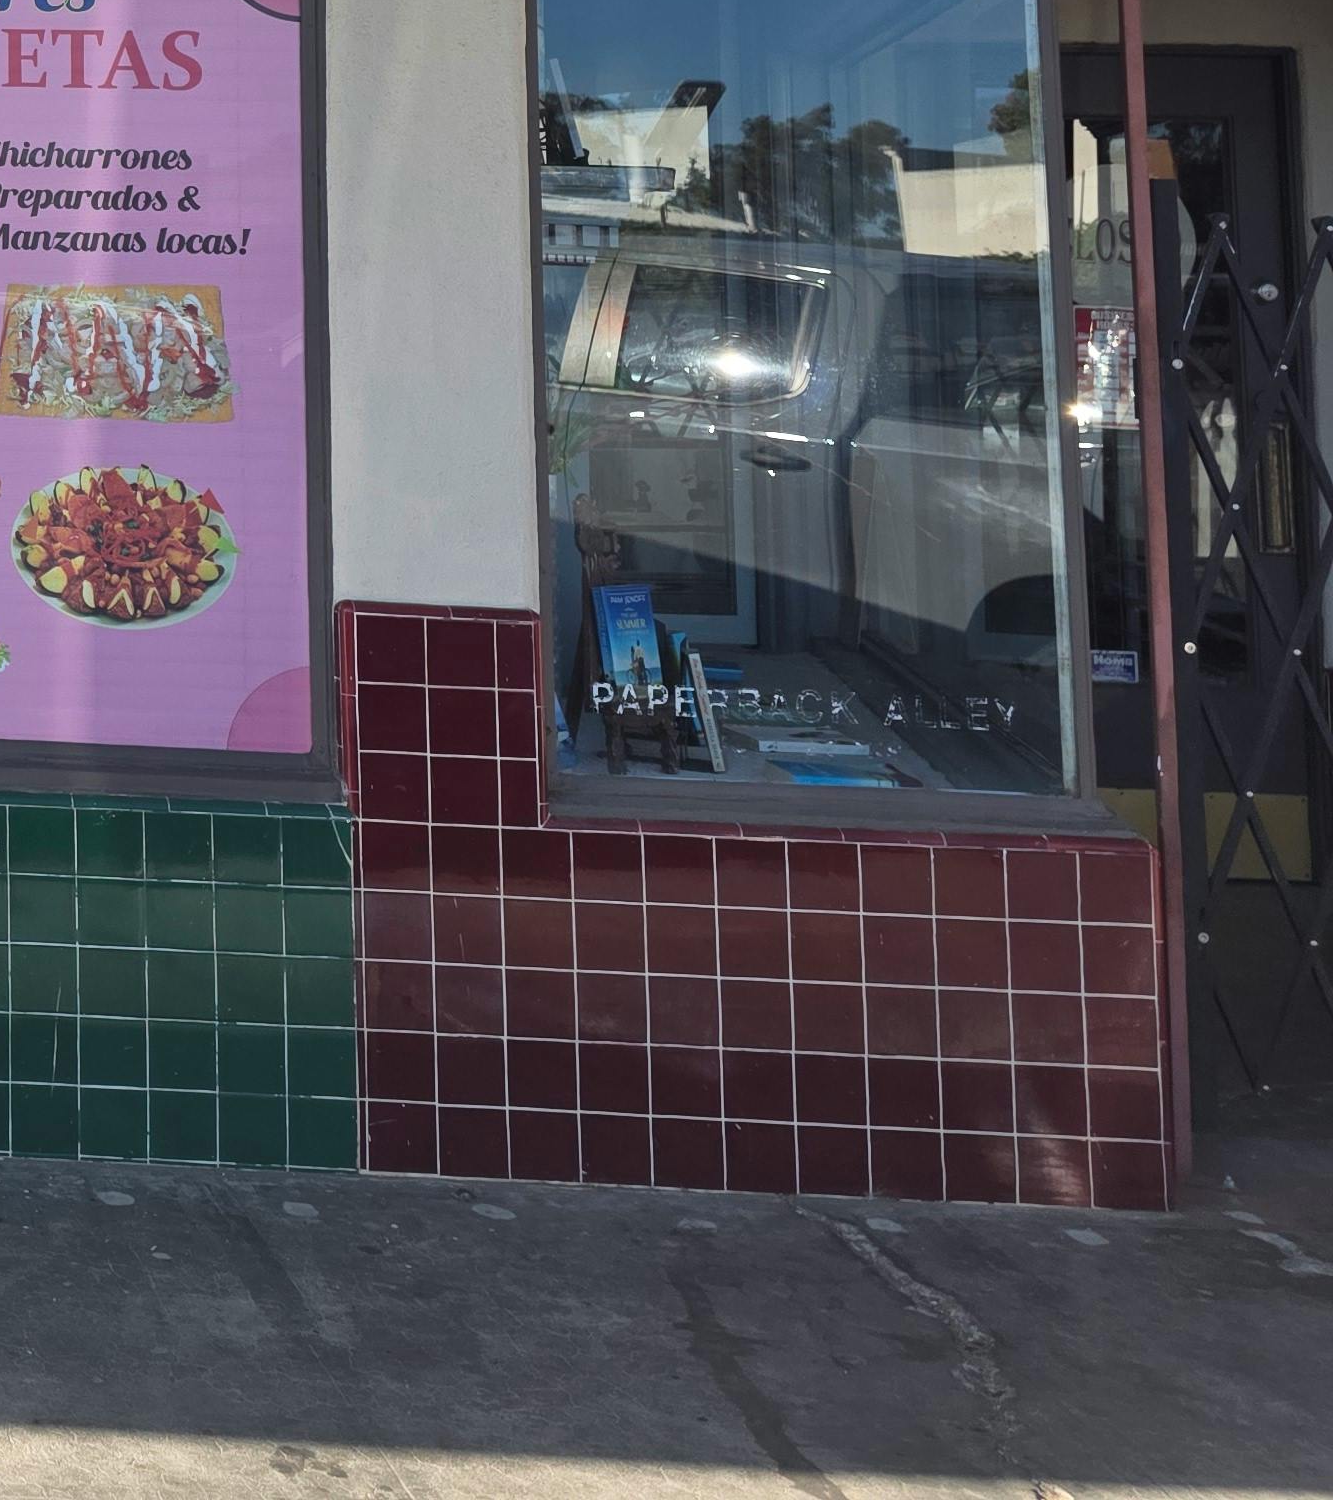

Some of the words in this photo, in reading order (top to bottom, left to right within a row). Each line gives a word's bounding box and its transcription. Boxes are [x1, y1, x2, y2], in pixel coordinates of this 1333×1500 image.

[177, 185, 201, 213] &
[156, 227, 252, 256] locas!
[882, 695, 1016, 732] ALLEY
